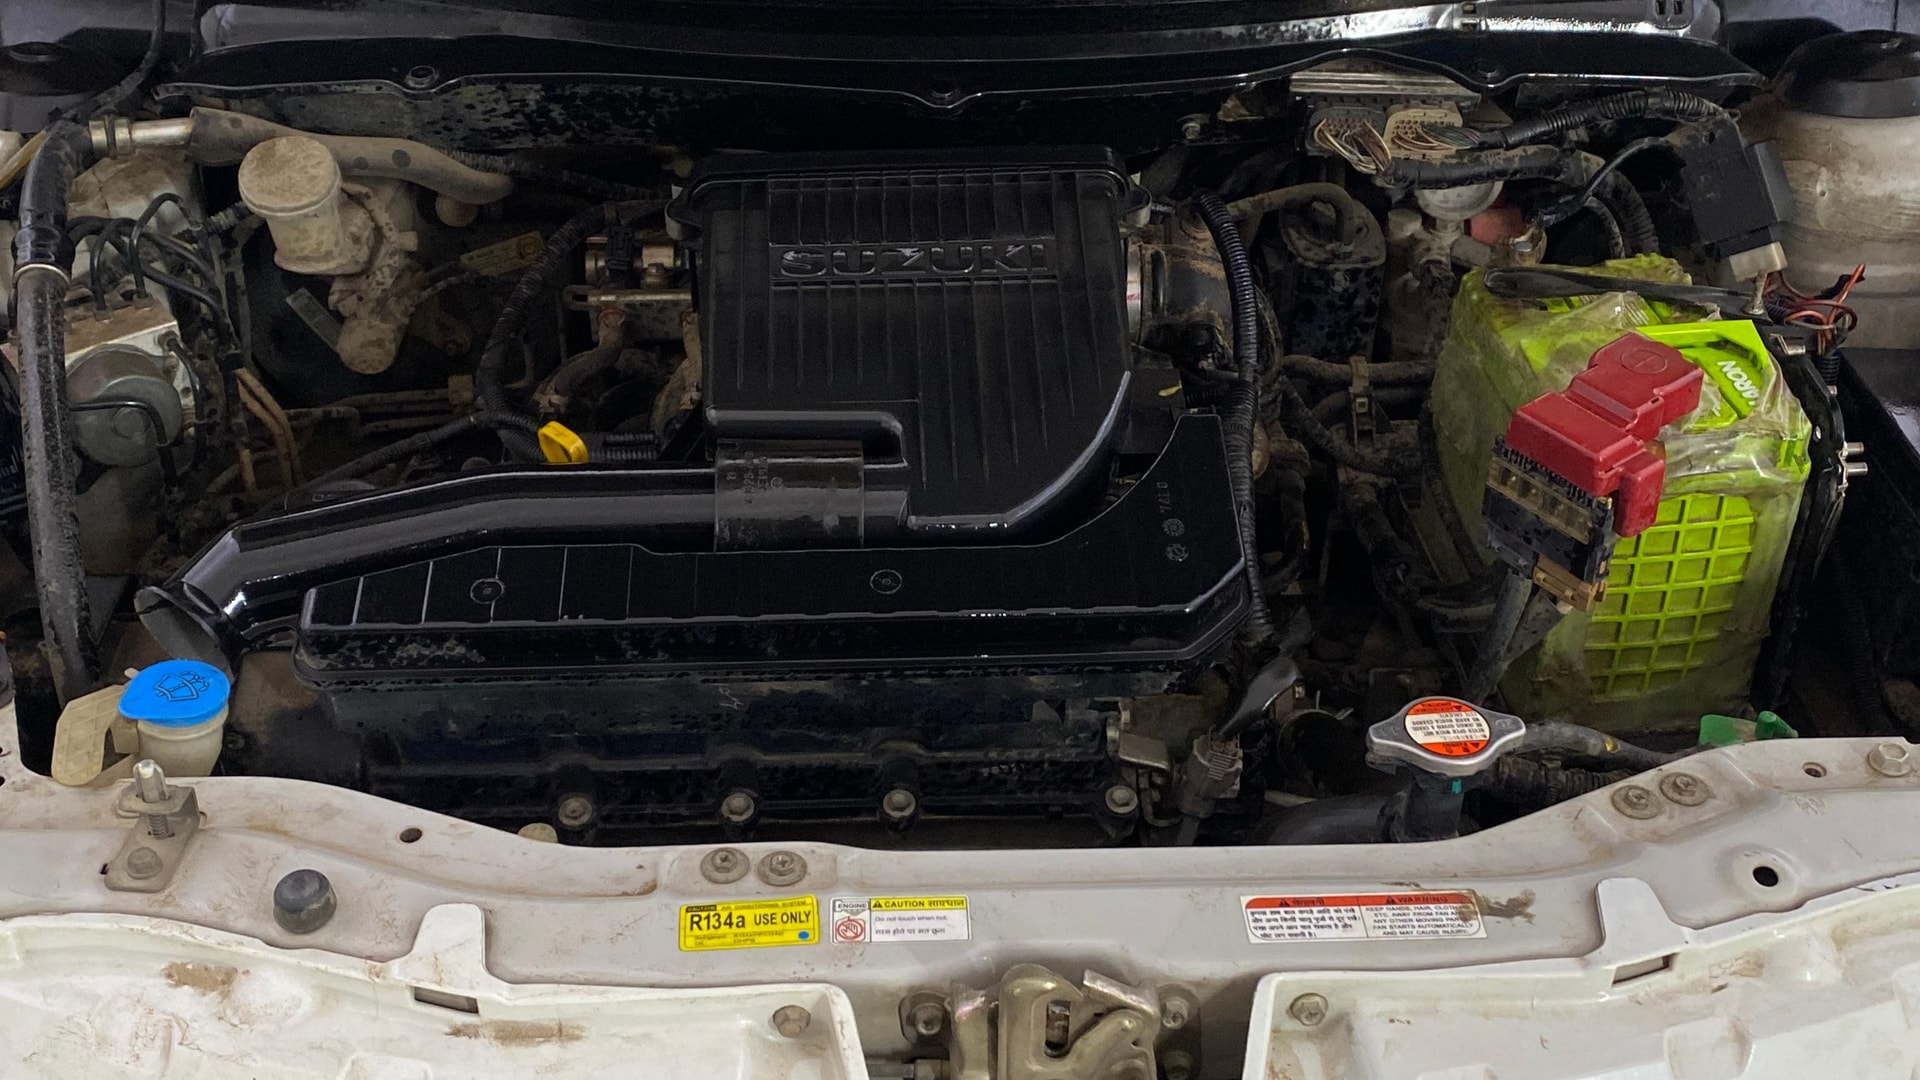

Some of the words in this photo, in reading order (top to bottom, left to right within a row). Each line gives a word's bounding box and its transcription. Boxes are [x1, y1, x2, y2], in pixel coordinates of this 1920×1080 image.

[780, 245, 1047, 277] SUZUKI
[1716, 360, 1761, 406] ARON
[884, 901, 924, 909] CAUTION
[1397, 895, 1448, 904] WARNING
[690, 912, 745, 931] R134a
[754, 912, 777, 926] USE
[781, 910, 811, 924] ONLY
[1417, 922, 1473, 930] AUTOMATICALLY
